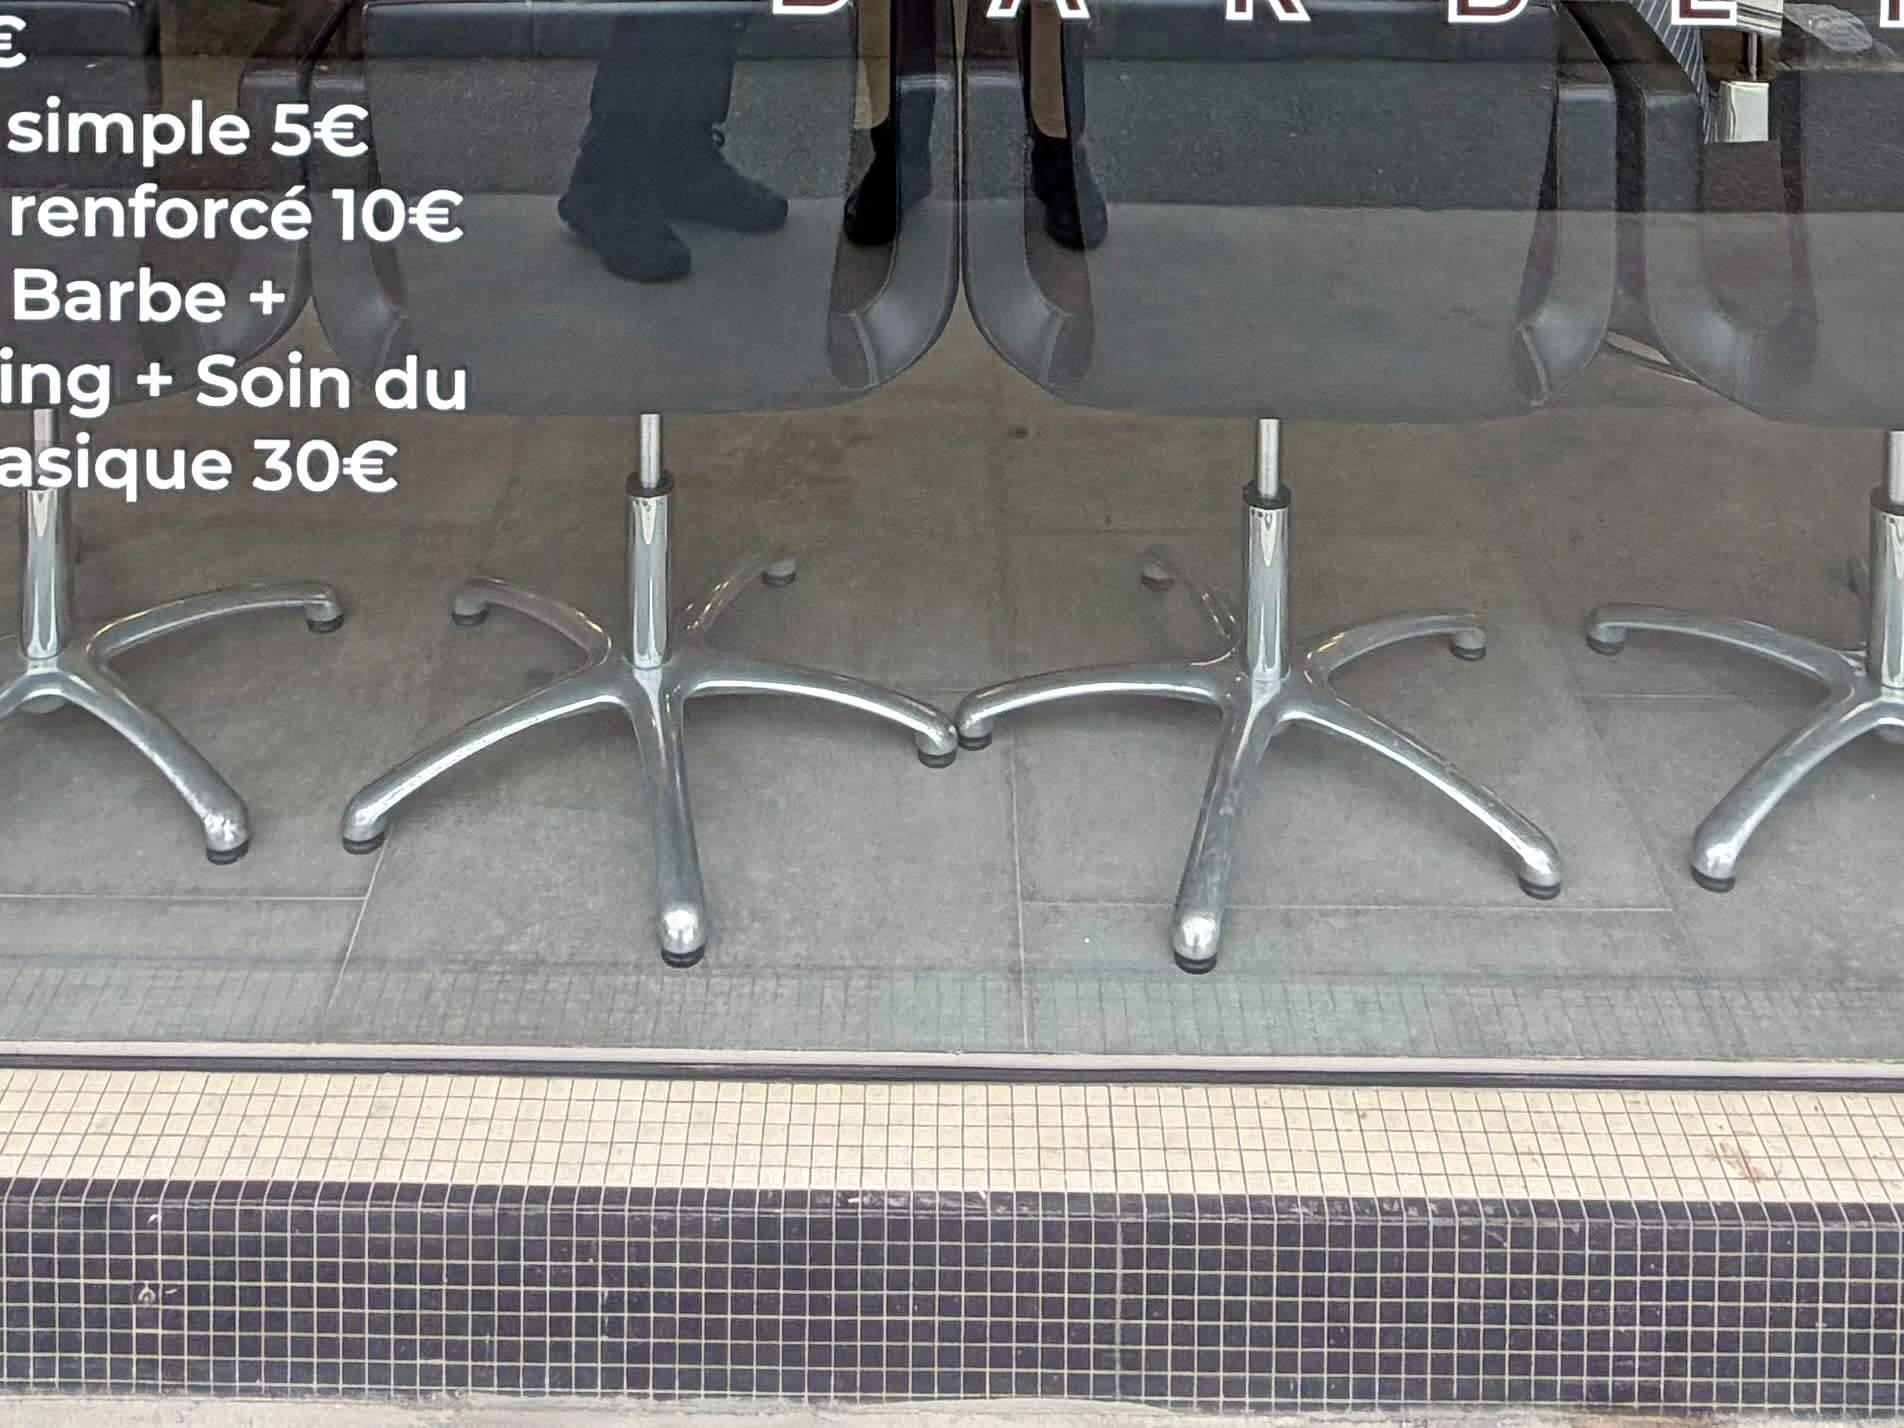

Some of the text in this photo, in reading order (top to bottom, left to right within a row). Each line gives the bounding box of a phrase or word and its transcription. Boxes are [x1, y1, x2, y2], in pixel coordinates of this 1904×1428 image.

[7, 95, 250, 168] simple
[271, 103, 369, 157] 5€
[11, 182, 312, 241] renforcé
[331, 188, 464, 243] 10€
[13, 267, 226, 323] Barbe
[249, 280, 286, 315] +
[136, 362, 173, 397] +
[196, 350, 350, 409] Soin
[374, 354, 466, 410] du
[252, 439, 398, 493] 30€
